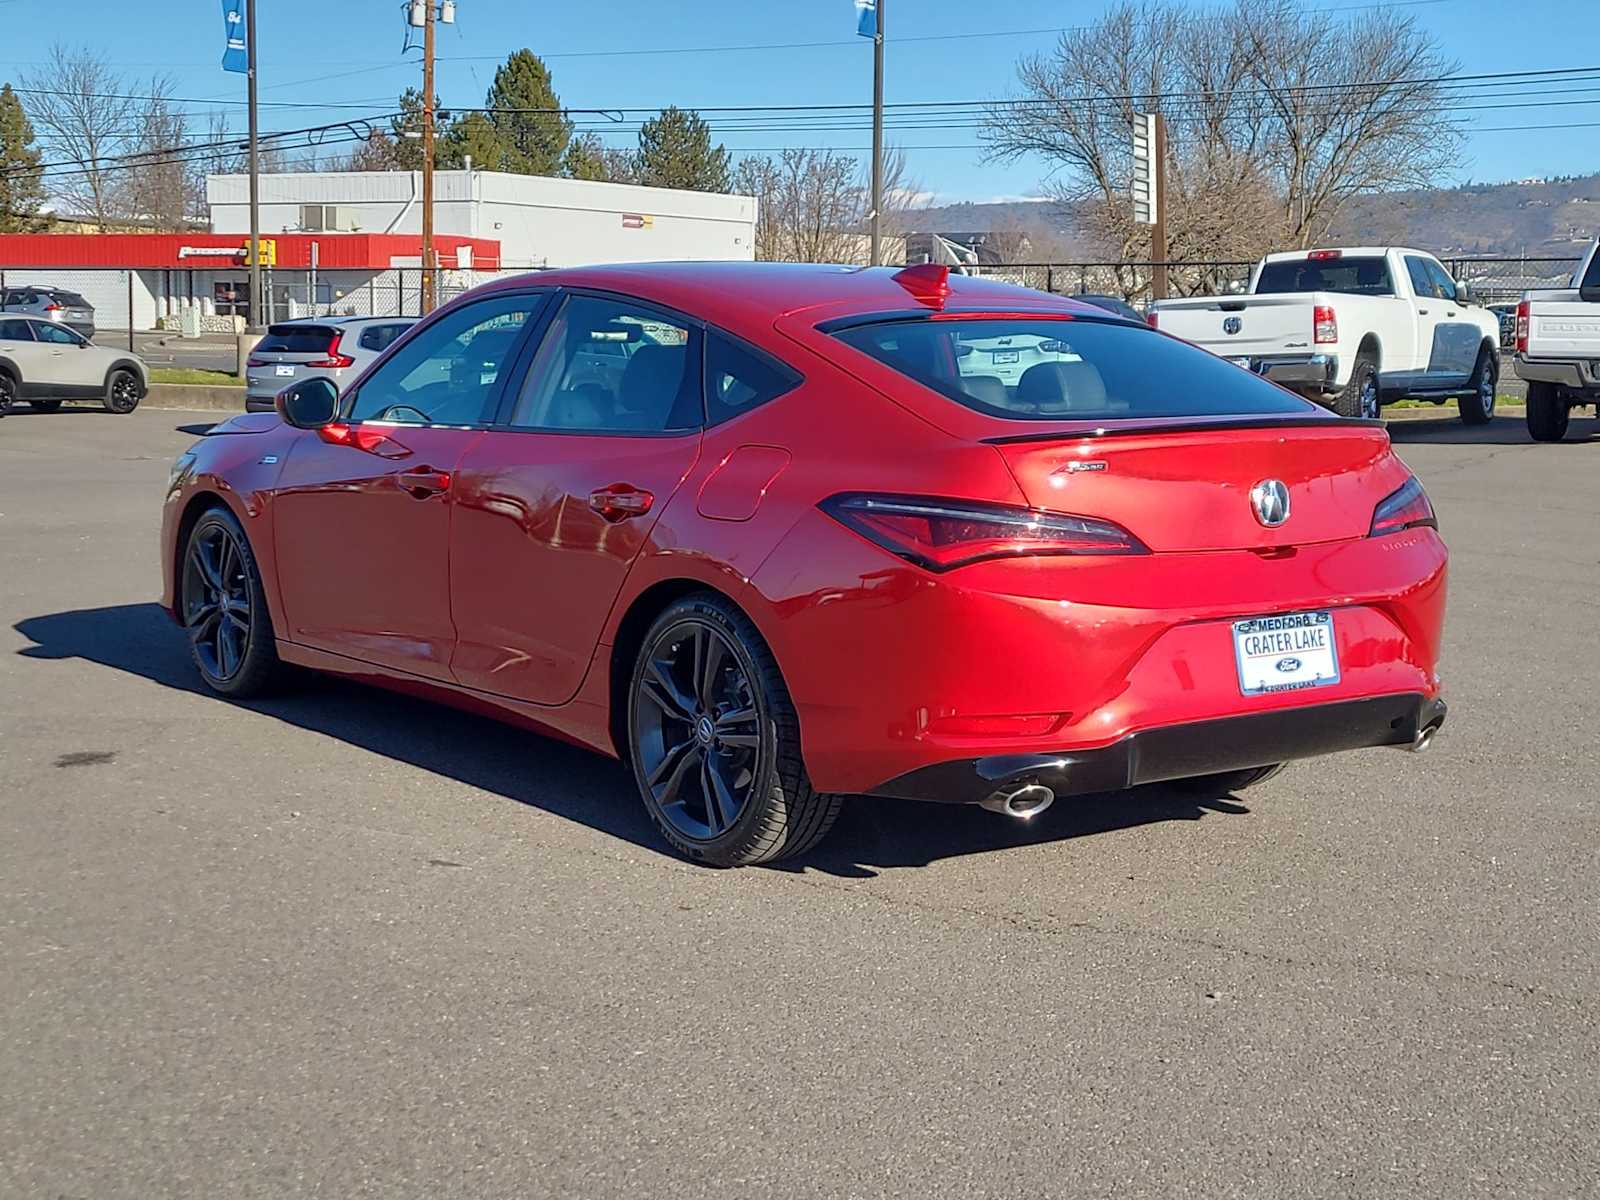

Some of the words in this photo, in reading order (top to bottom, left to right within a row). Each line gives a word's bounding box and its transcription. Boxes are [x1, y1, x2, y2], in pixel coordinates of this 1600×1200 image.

[1258, 615, 1311, 632] MEDFORD
[1244, 632, 1293, 655] CRATER
[1295, 629, 1325, 649] LAKE
